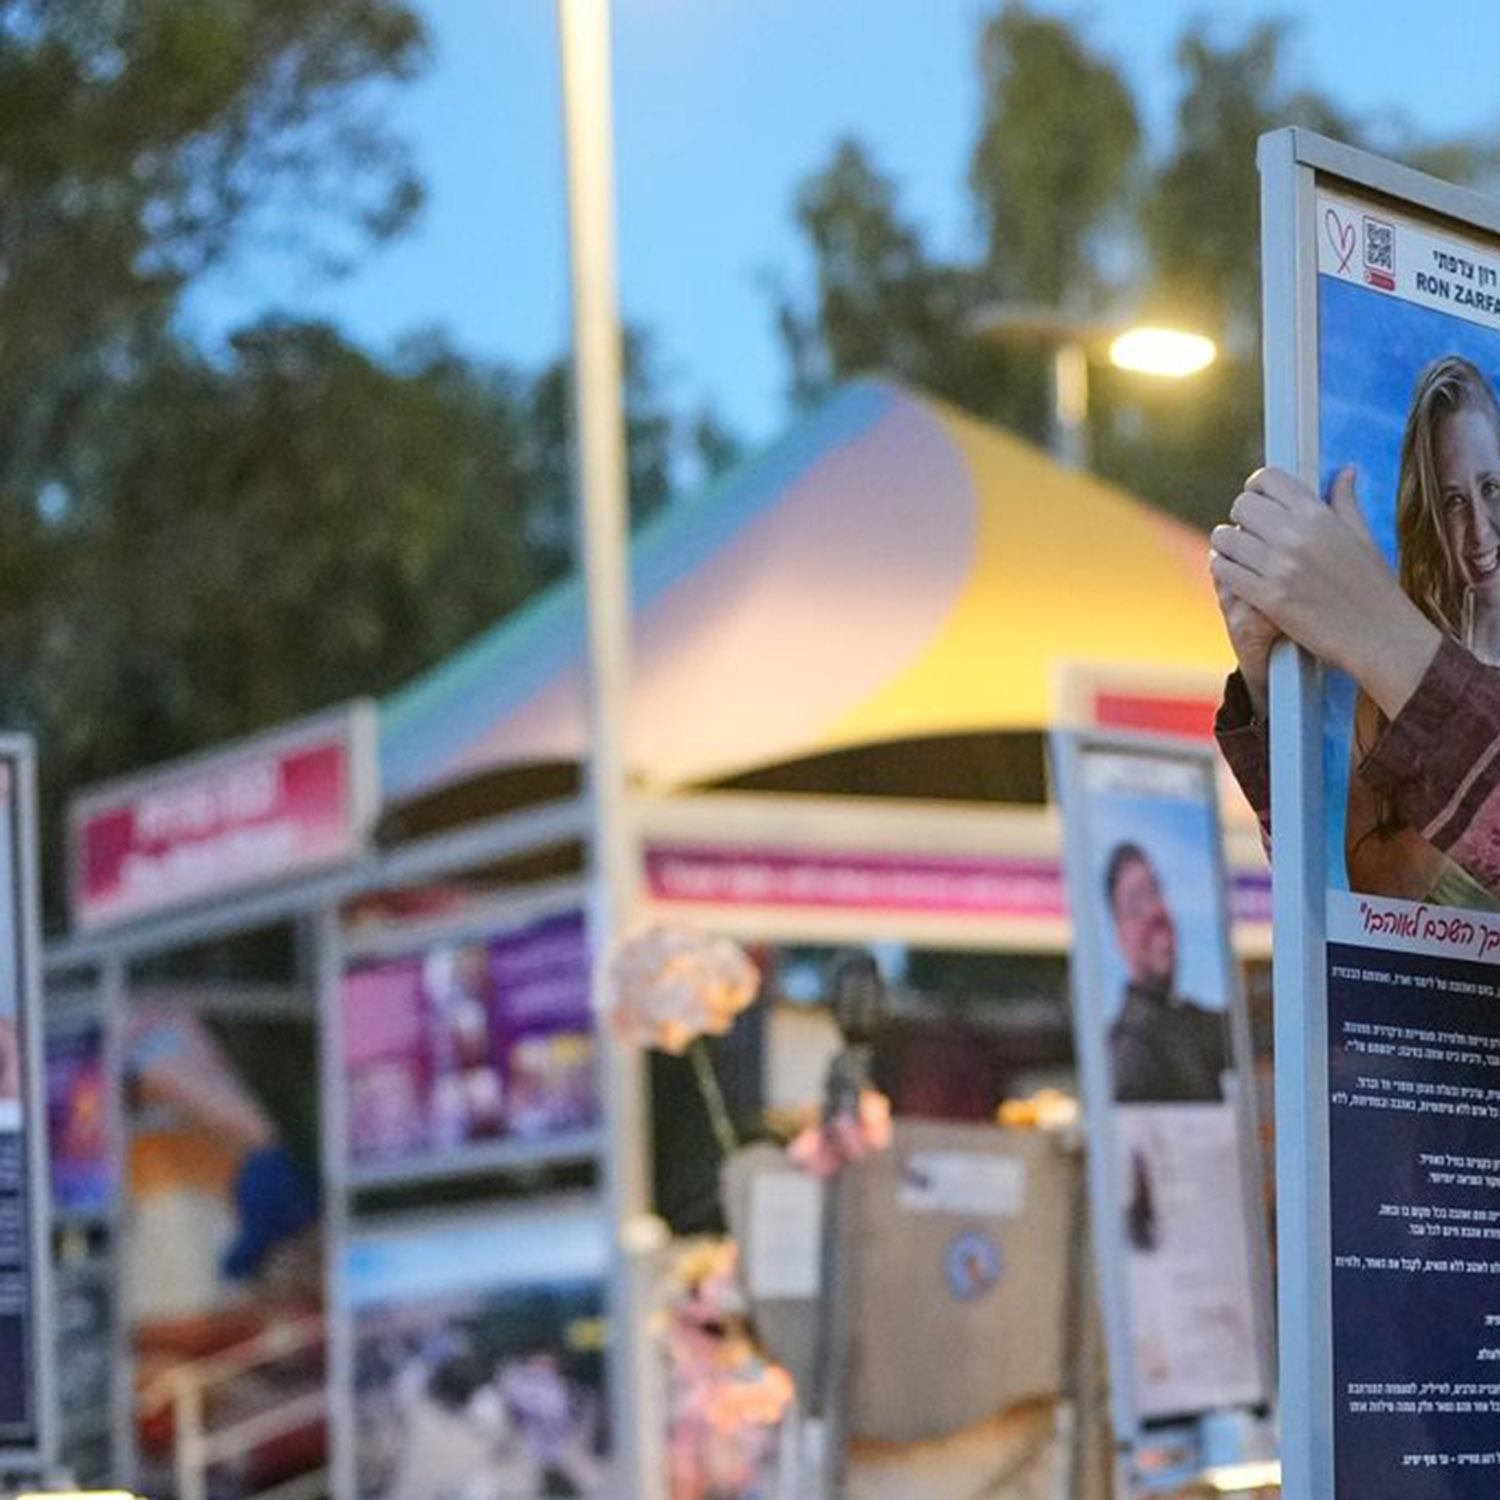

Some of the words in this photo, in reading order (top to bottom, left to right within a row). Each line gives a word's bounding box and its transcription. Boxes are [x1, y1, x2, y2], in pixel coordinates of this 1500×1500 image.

[1432, 250, 1475, 280] צרפתי
[1478, 264, 1498, 287] רון
[1416, 271, 1450, 299] RON
[1424, 916, 1475, 945] השכם
